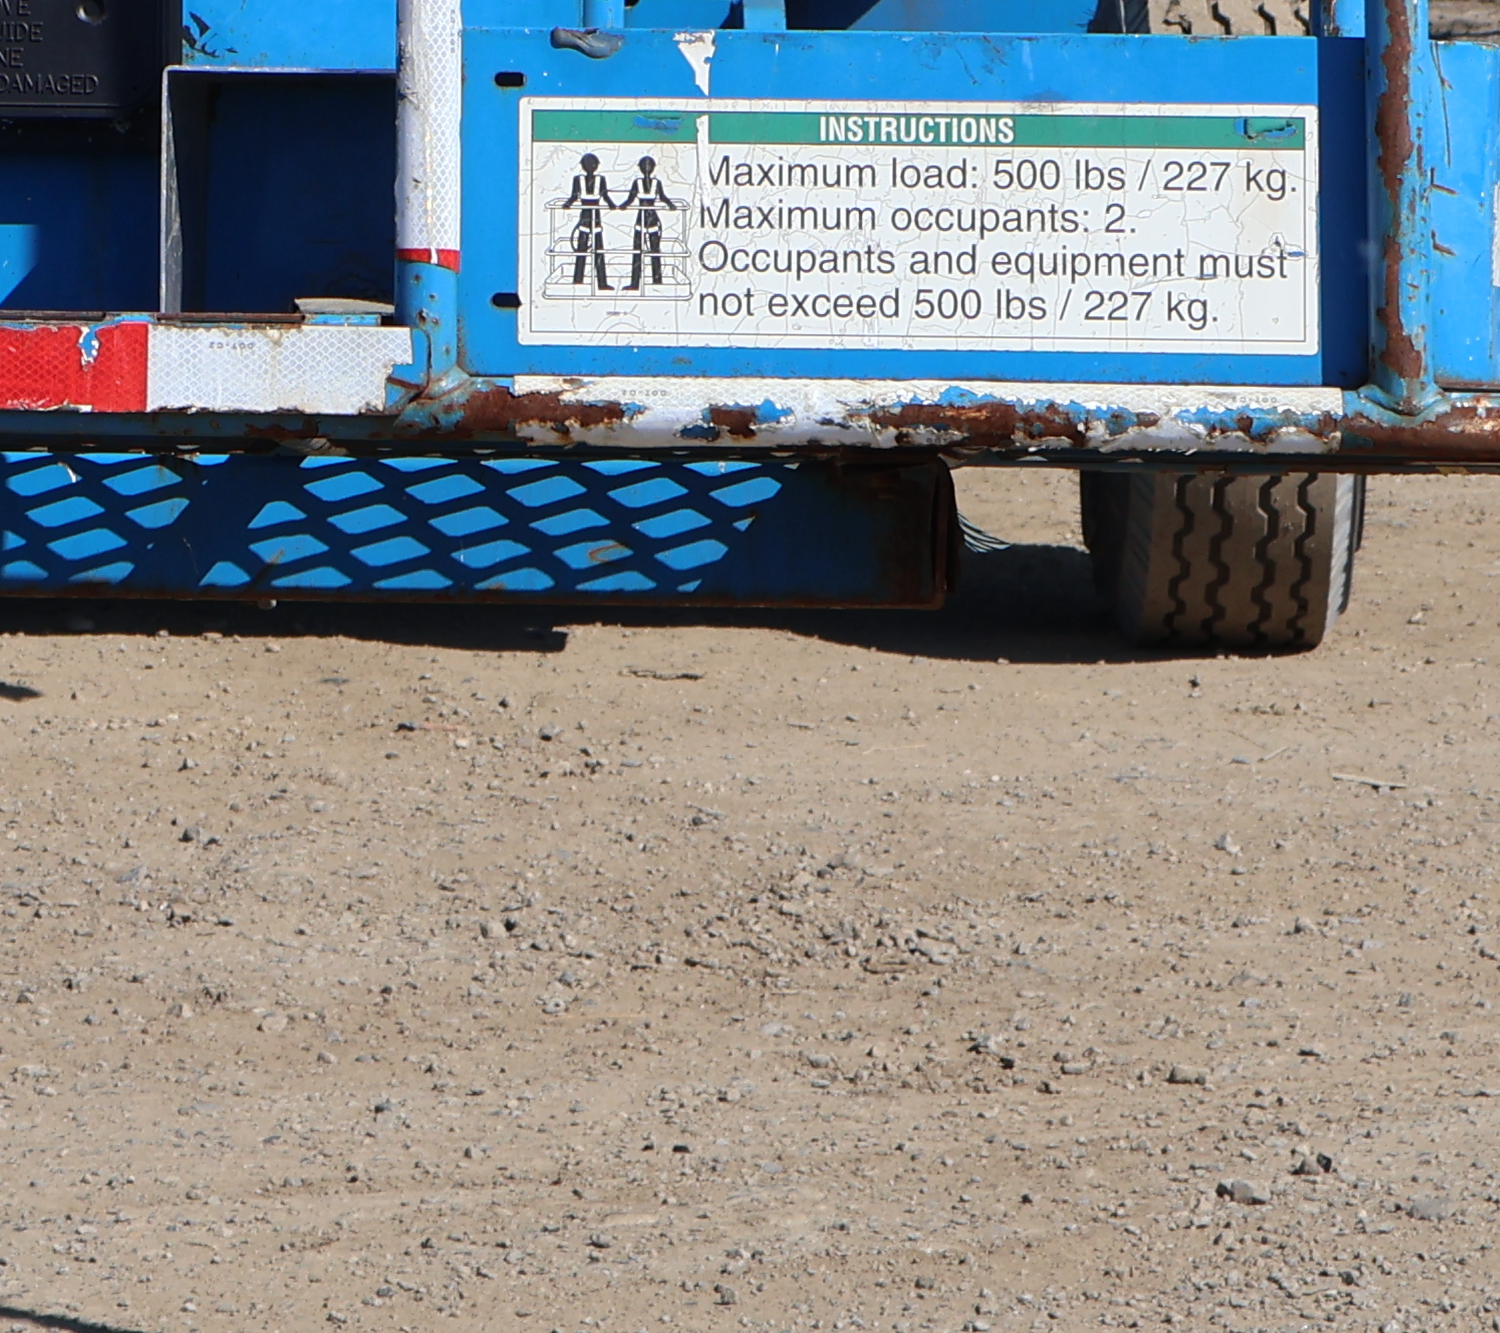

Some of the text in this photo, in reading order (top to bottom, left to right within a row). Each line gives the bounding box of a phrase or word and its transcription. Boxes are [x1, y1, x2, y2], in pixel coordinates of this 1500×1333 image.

[820, 116, 1014, 143] INSTRUCTIONS
[708, 155, 1298, 201] Maximum load: 500 lbs / 227 kg.
[700, 198, 1136, 240] Maximum occupants: 2.
[699, 240, 1289, 284] Occupants and equipment must
[700, 288, 1218, 330] not exceed 500 lbs / 227 kg.
